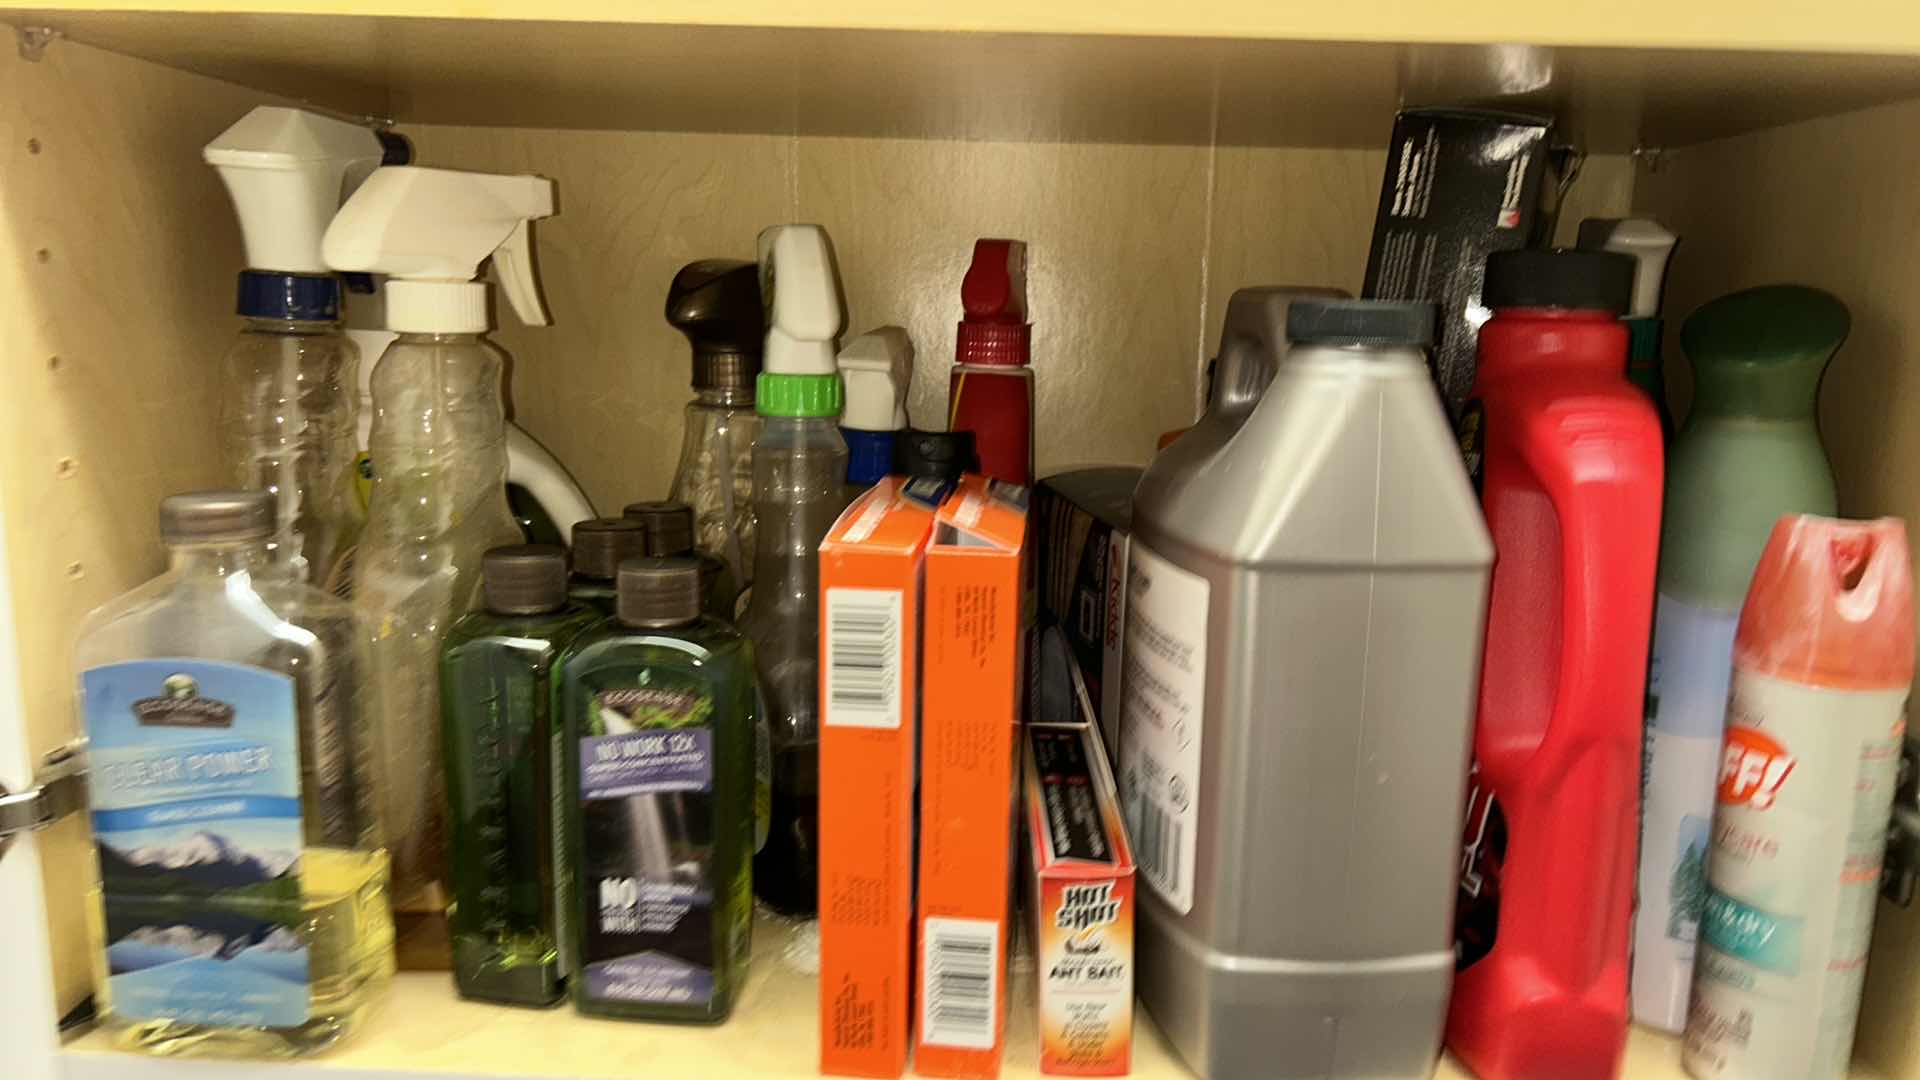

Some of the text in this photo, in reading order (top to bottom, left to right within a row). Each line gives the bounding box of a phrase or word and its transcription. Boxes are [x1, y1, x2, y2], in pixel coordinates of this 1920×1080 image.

[596, 741, 621, 761] NO
[622, 735, 668, 760] WORK
[102, 746, 273, 791] CLEAR POWER
[600, 877, 638, 909] NO
[1064, 884, 1112, 908] HOT
[1057, 900, 1119, 932] SHOT
[1048, 965, 1123, 980] ANT BAIT
